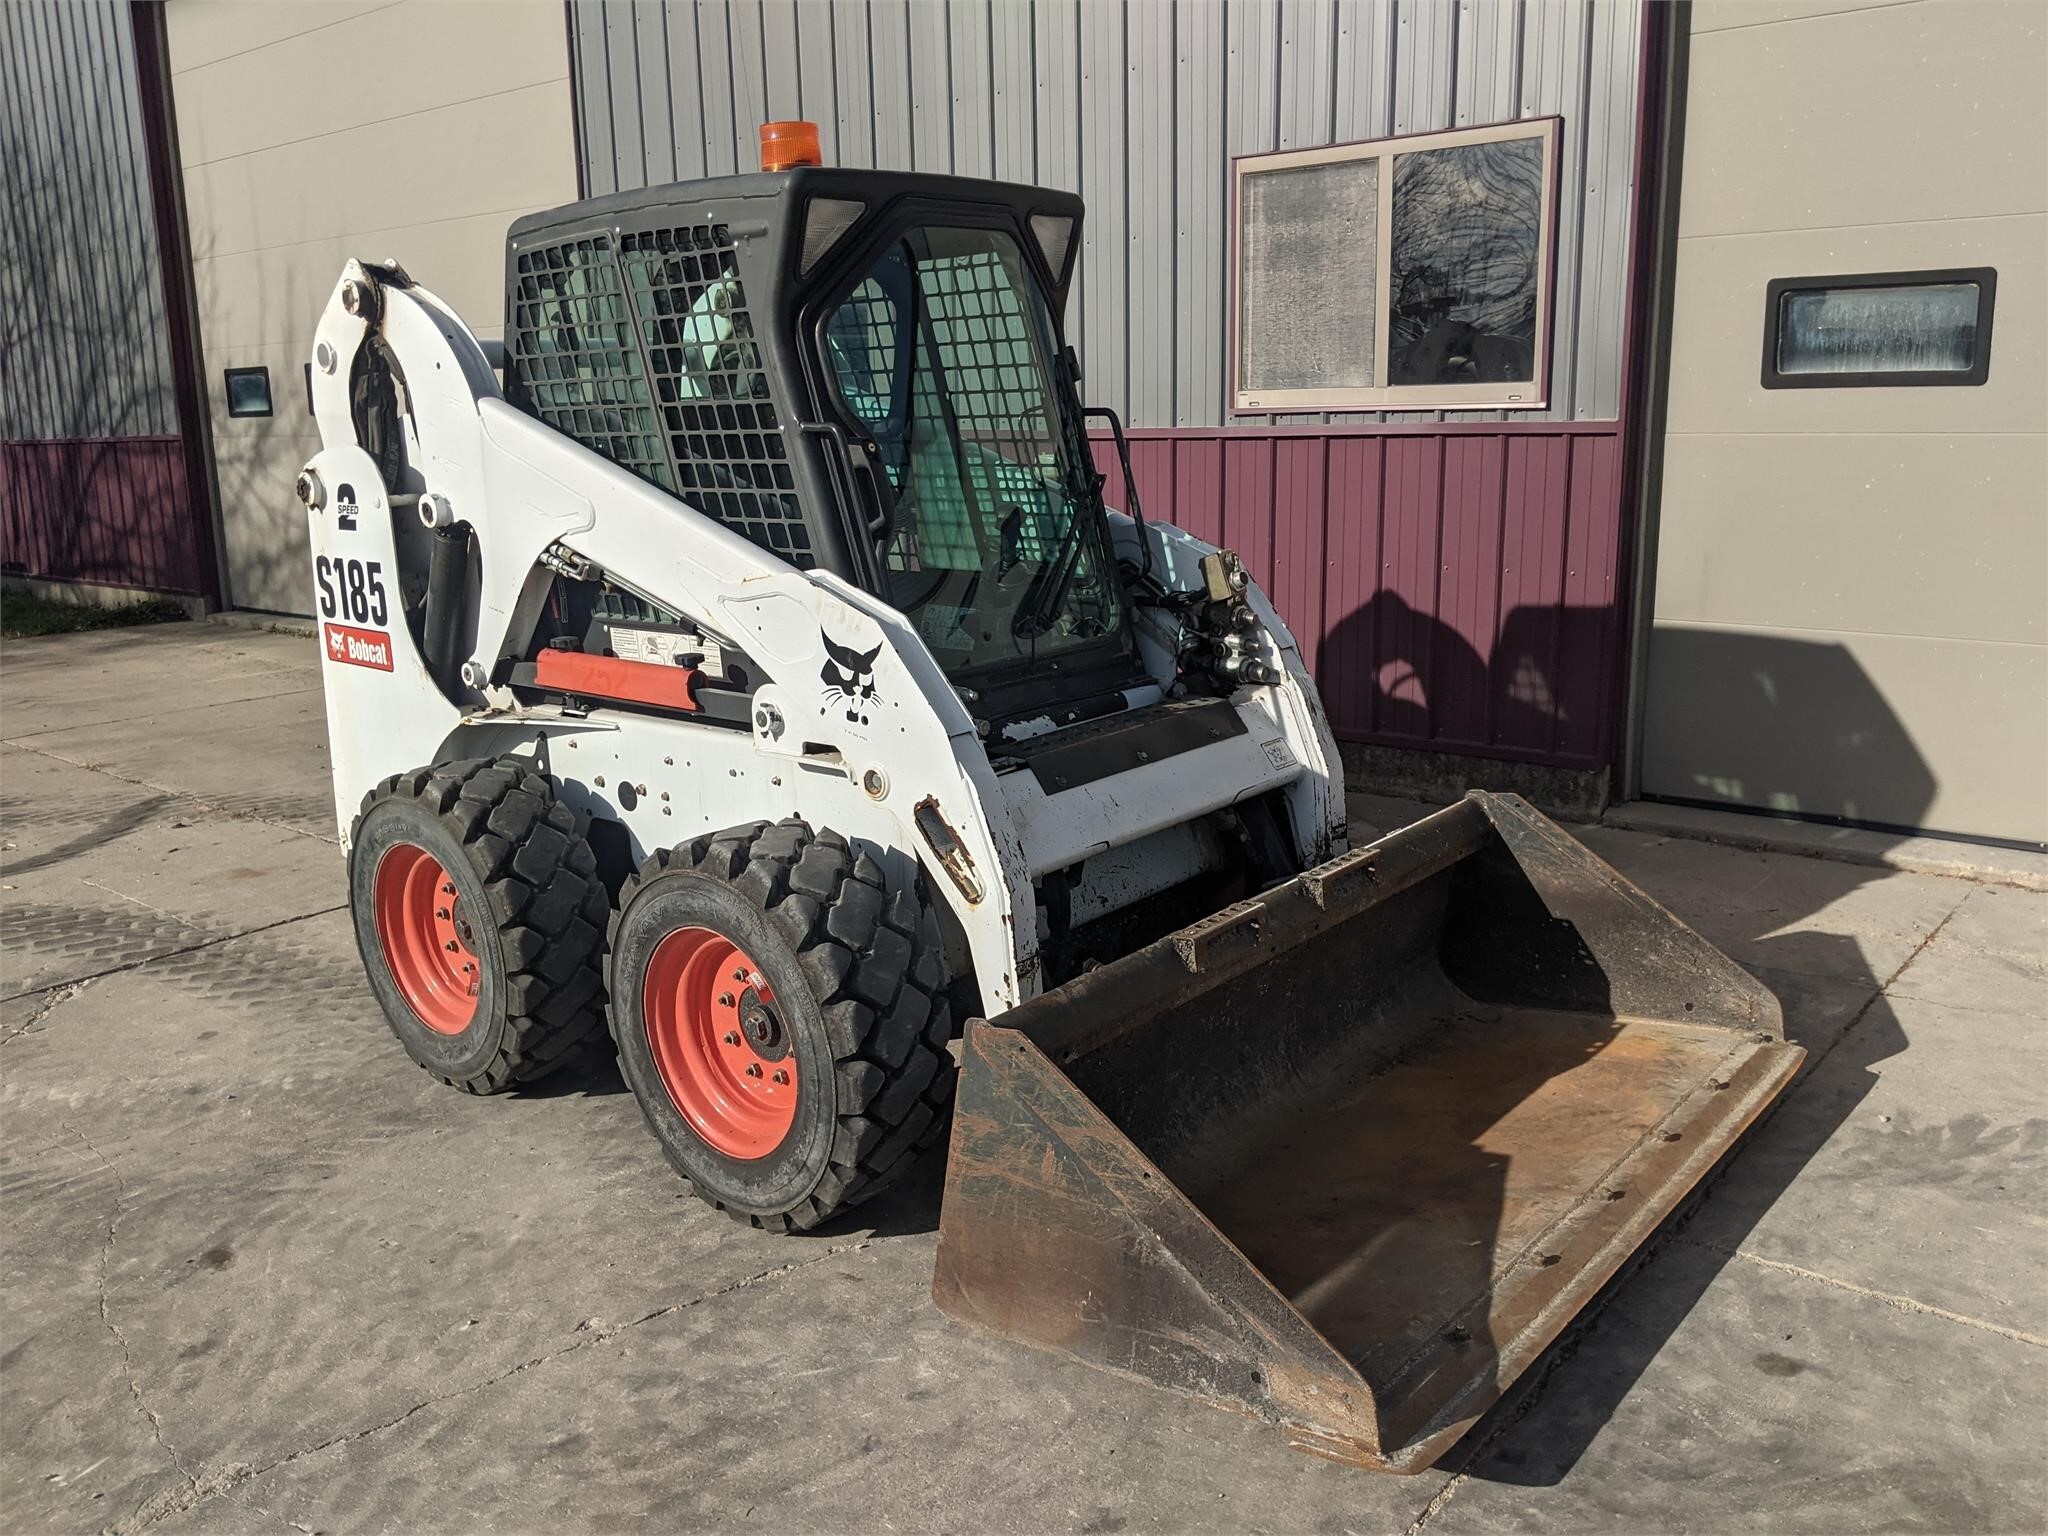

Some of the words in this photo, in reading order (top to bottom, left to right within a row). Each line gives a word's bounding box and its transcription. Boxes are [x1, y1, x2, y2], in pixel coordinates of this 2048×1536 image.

[337, 483, 357, 531] 2
[337, 504, 359, 515] SPEED
[317, 555, 388, 626] S185
[347, 636, 388, 665] Bobcat
